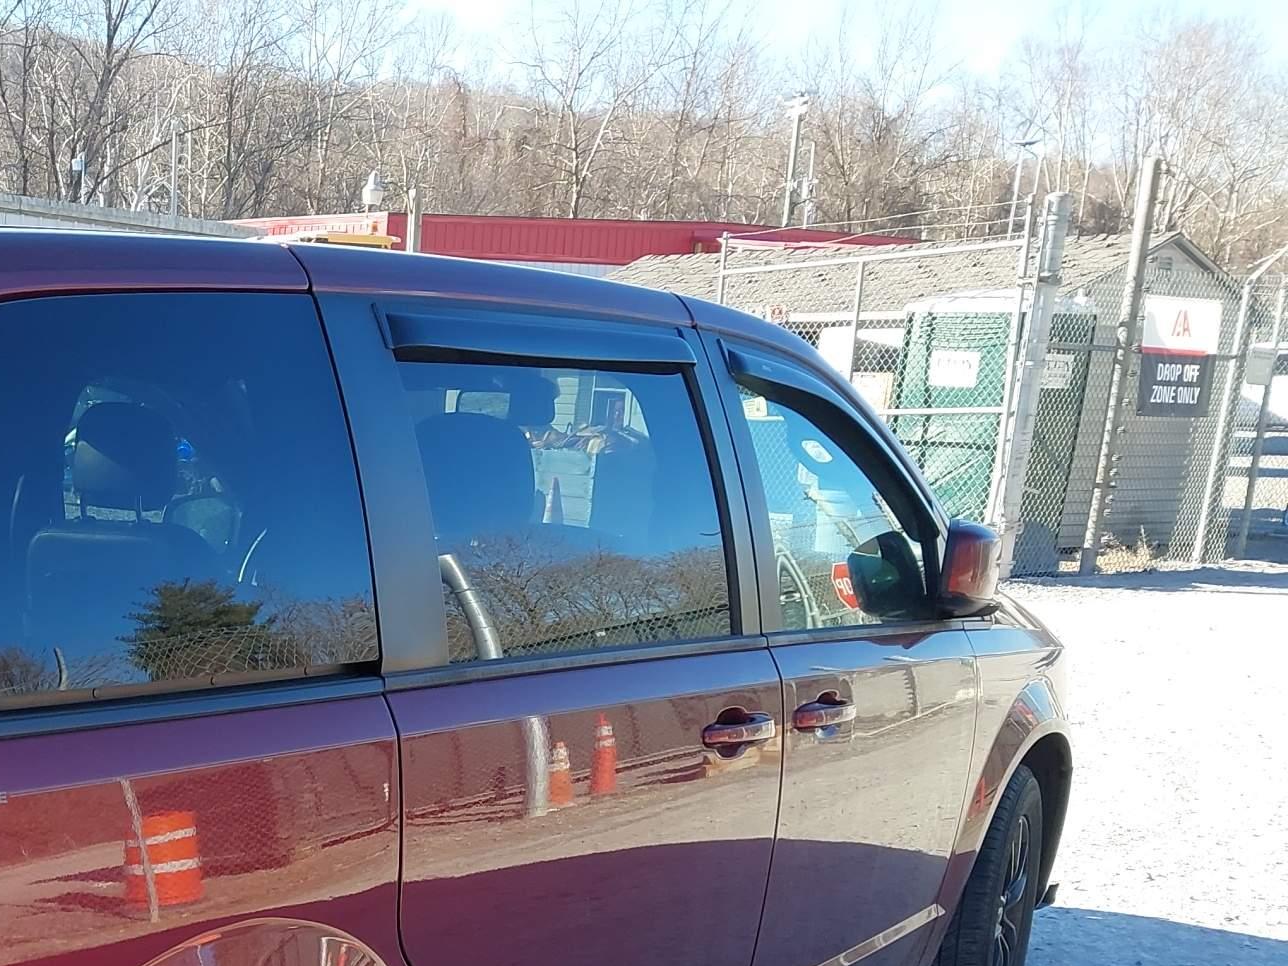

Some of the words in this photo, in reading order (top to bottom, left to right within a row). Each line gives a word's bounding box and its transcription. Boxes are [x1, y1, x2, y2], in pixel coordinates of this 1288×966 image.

[1156, 363, 1182, 381] DROP
[1183, 364, 1201, 383] OFF
[1150, 385, 1177, 403] ZONE
[1177, 386, 1201, 404] ONLY
